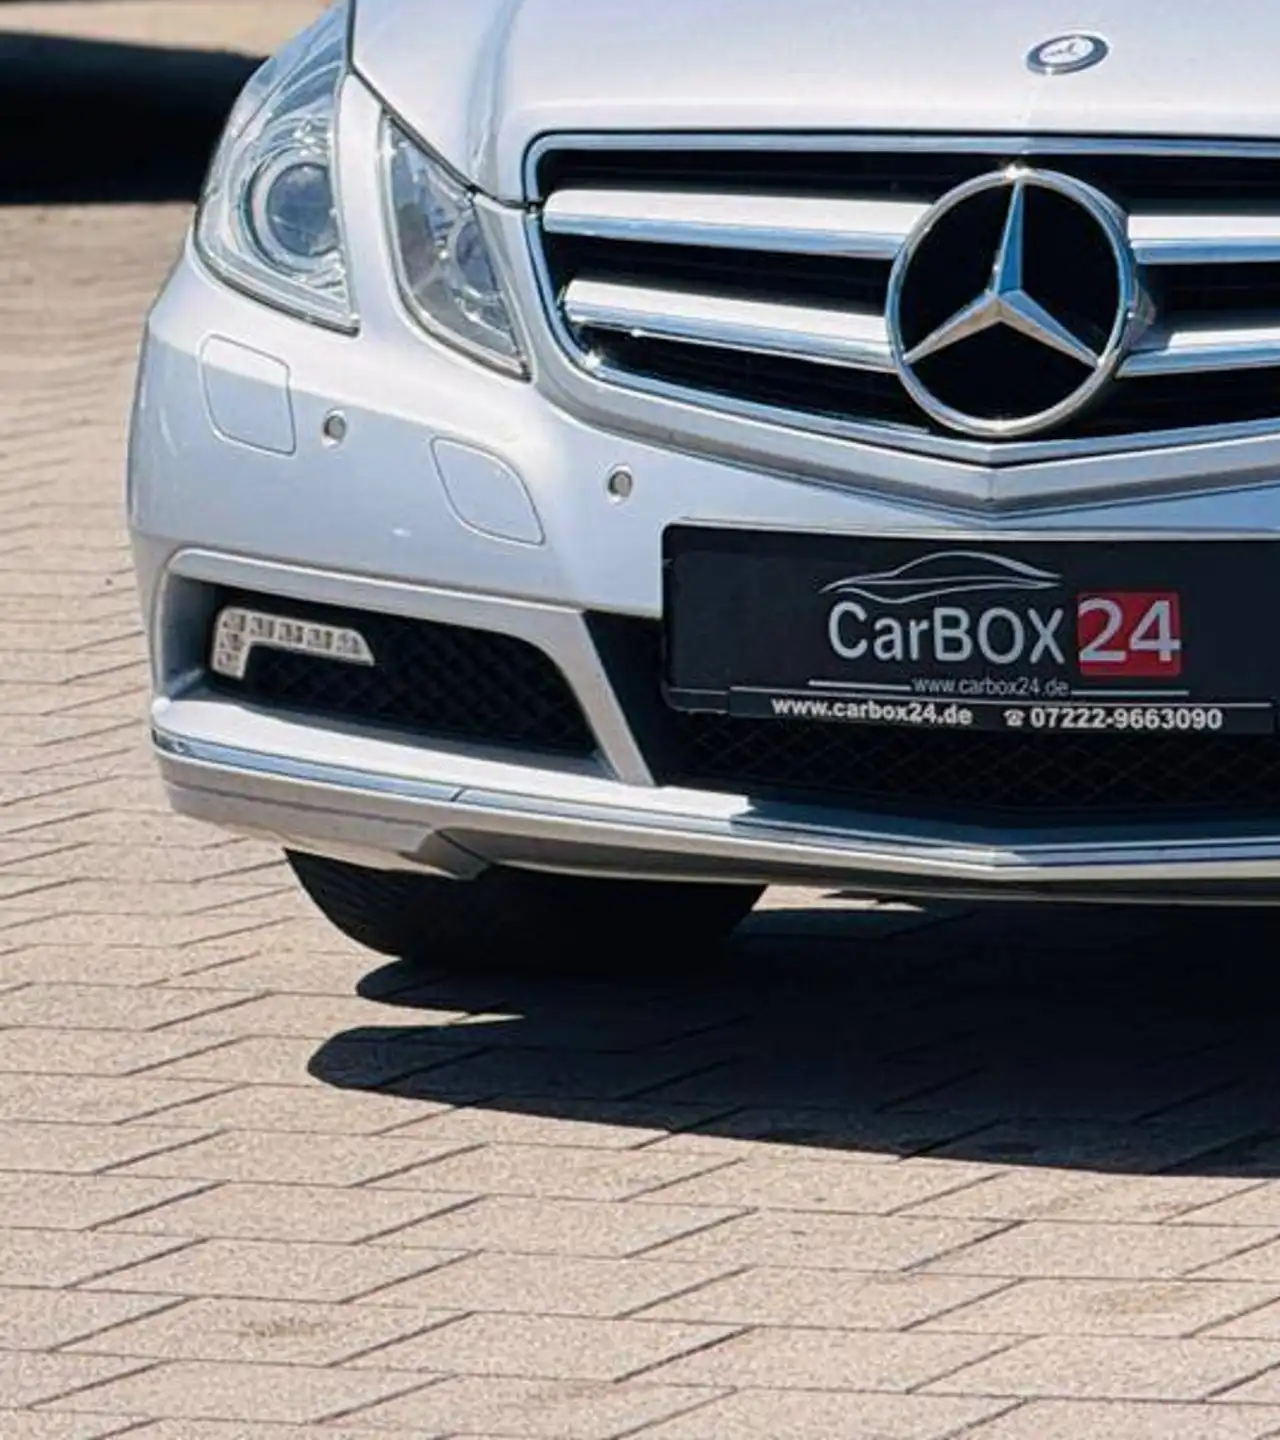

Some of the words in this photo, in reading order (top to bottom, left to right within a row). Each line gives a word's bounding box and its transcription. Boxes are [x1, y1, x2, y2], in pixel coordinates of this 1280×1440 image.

[828, 601, 1065, 665] CarBOX
[1078, 598, 1182, 663] 24
[911, 676, 1070, 698] www.carbox24.de
[771, 696, 974, 726] www.carbox24.de
[1030, 707, 1223, 731] 07222-9663090
